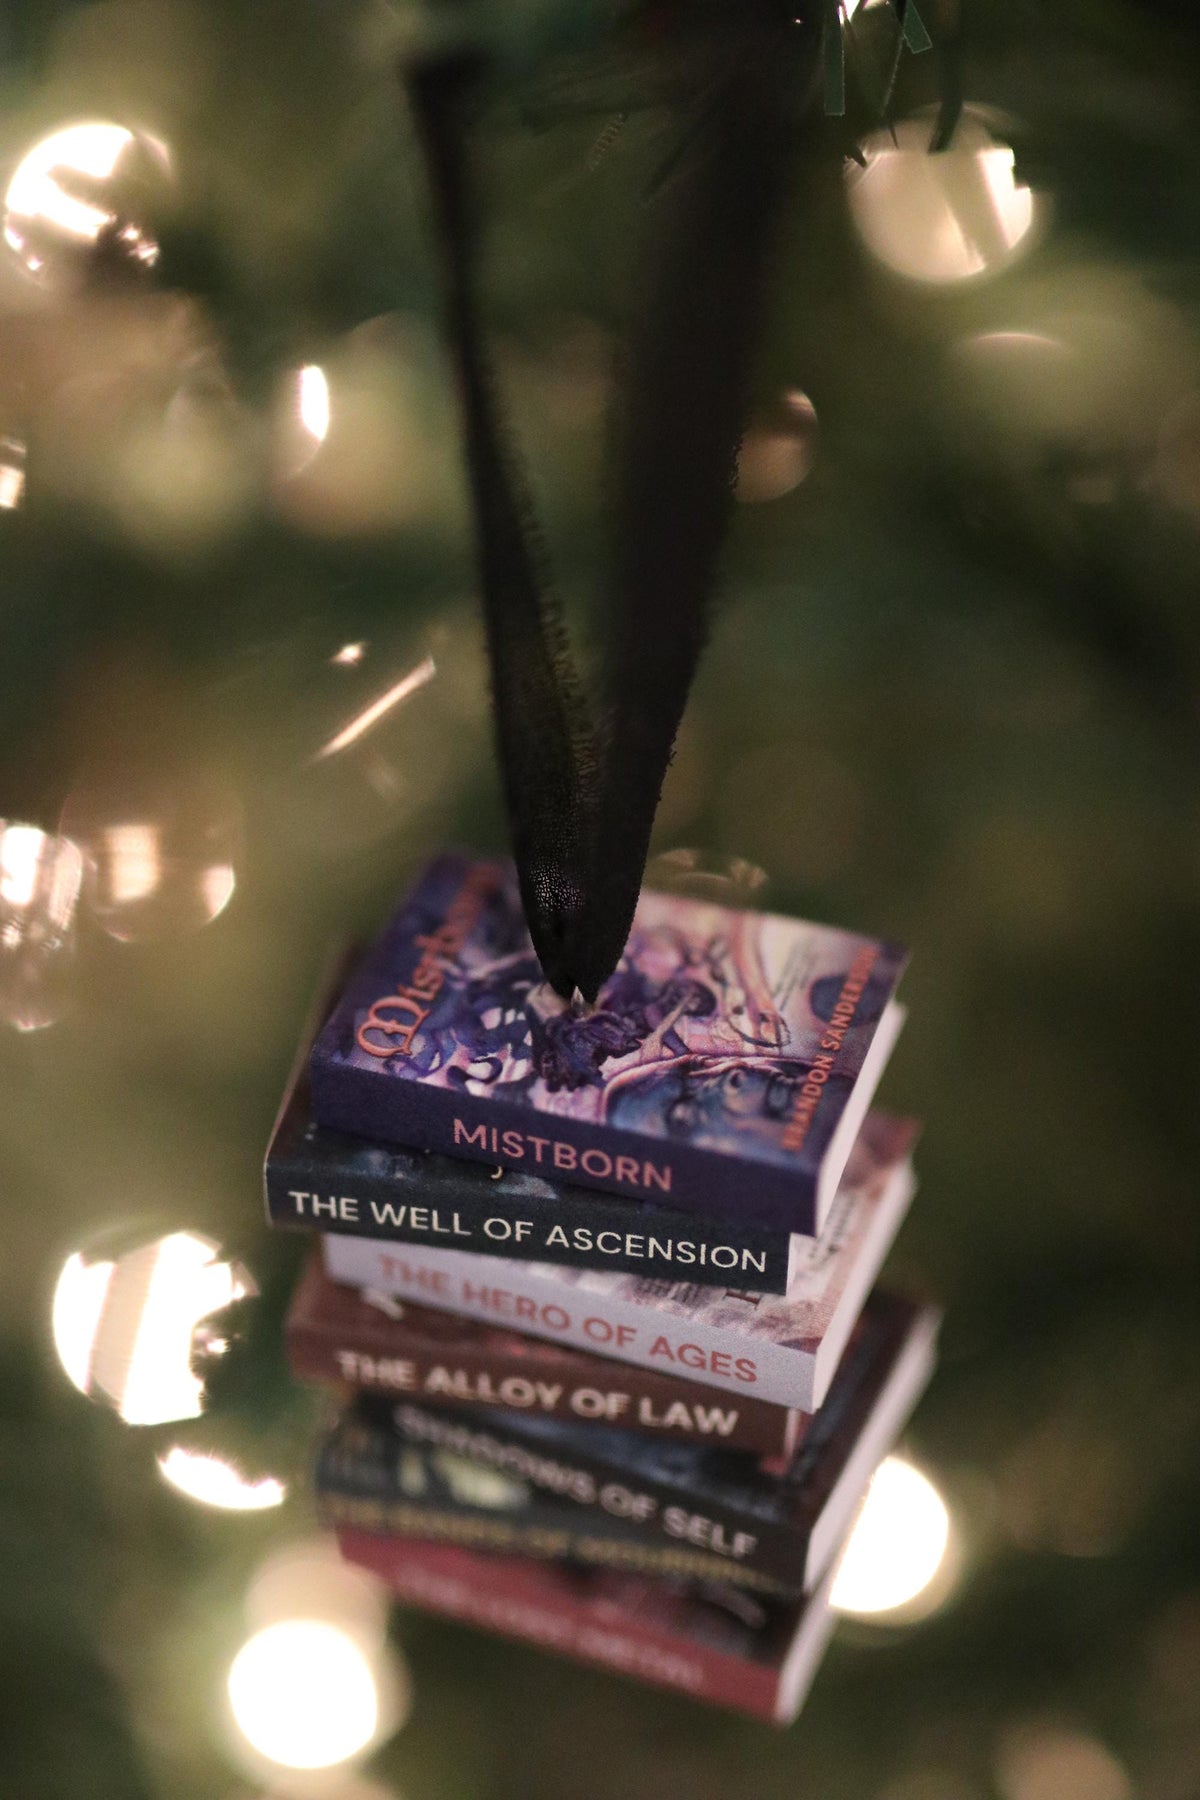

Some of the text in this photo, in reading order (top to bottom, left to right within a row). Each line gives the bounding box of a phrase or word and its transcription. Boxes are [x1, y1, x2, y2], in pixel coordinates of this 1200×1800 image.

[453, 1118, 672, 1193] MISTBORN
[288, 1190, 767, 1273] THE WELL OF ASCENSION
[378, 1252, 758, 1383] THE HERO OF AGES
[336, 1350, 740, 1437] THE ALLOY OF LAW
[600, 1483, 660, 1524] OF
[663, 1505, 758, 1559] SELF
